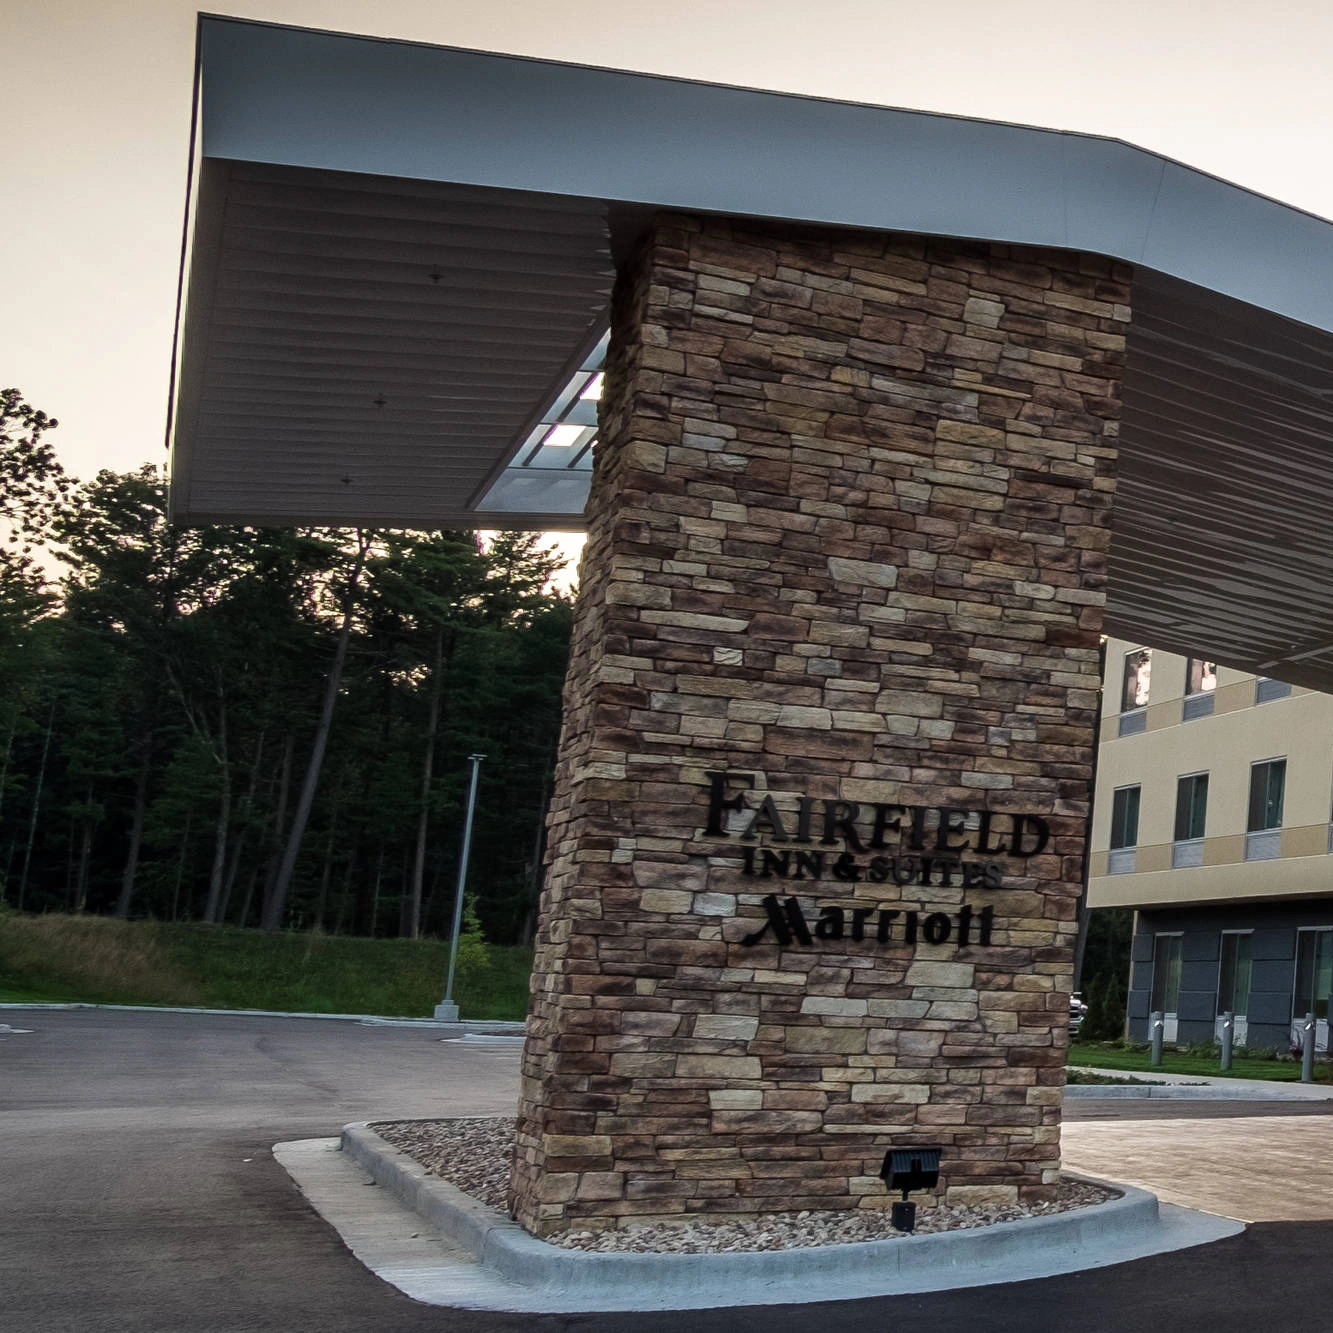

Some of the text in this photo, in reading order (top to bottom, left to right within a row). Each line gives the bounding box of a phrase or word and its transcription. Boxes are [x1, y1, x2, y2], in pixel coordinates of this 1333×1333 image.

[702, 770, 1050, 857] FAIRFIELD
[741, 847, 1002, 889] INN & SUITES
[741, 894, 994, 947] Marriott
